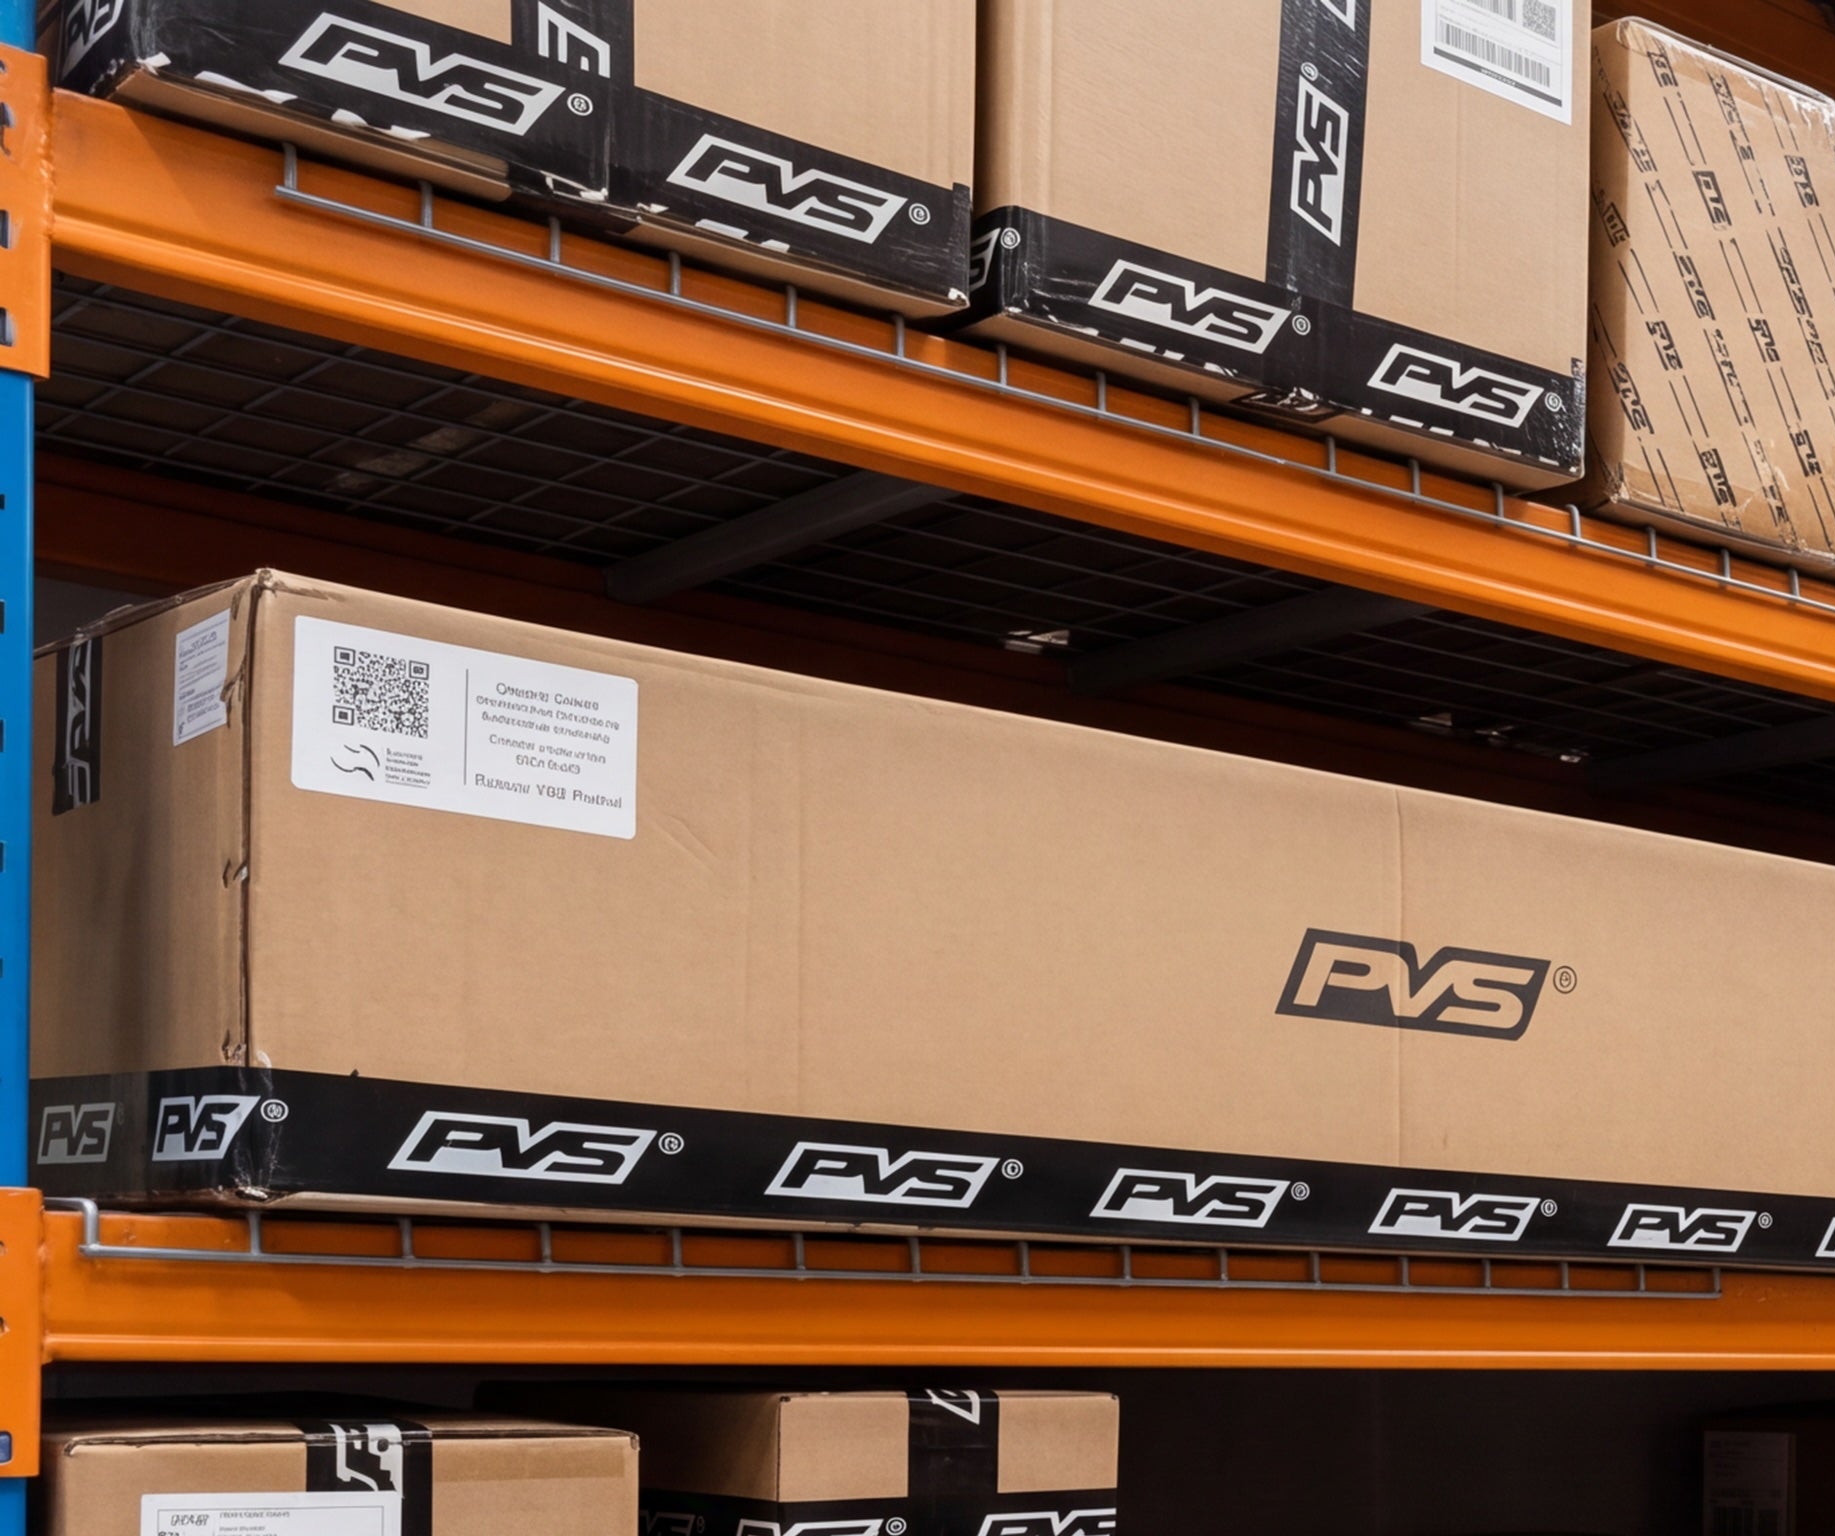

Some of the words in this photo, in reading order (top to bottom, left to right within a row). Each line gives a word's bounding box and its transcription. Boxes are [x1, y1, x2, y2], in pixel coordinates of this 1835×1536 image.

[296, 20, 546, 128] PVS
[681, 140, 892, 236] PVS
[1294, 87, 1345, 236] PVS
[1098, 264, 1278, 348] PVS
[1376, 348, 1534, 423] PVS
[1290, 940, 1536, 1031] PVS
[39, 1108, 112, 1159] PVS
[153, 1100, 242, 1156] PVS
[403, 1116, 643, 1178] PVS
[777, 1146, 986, 1203] PVS
[1100, 1172, 1279, 1223] PVS
[1377, 1191, 1532, 1237] PVS
[1615, 1206, 1749, 1249] PVS
